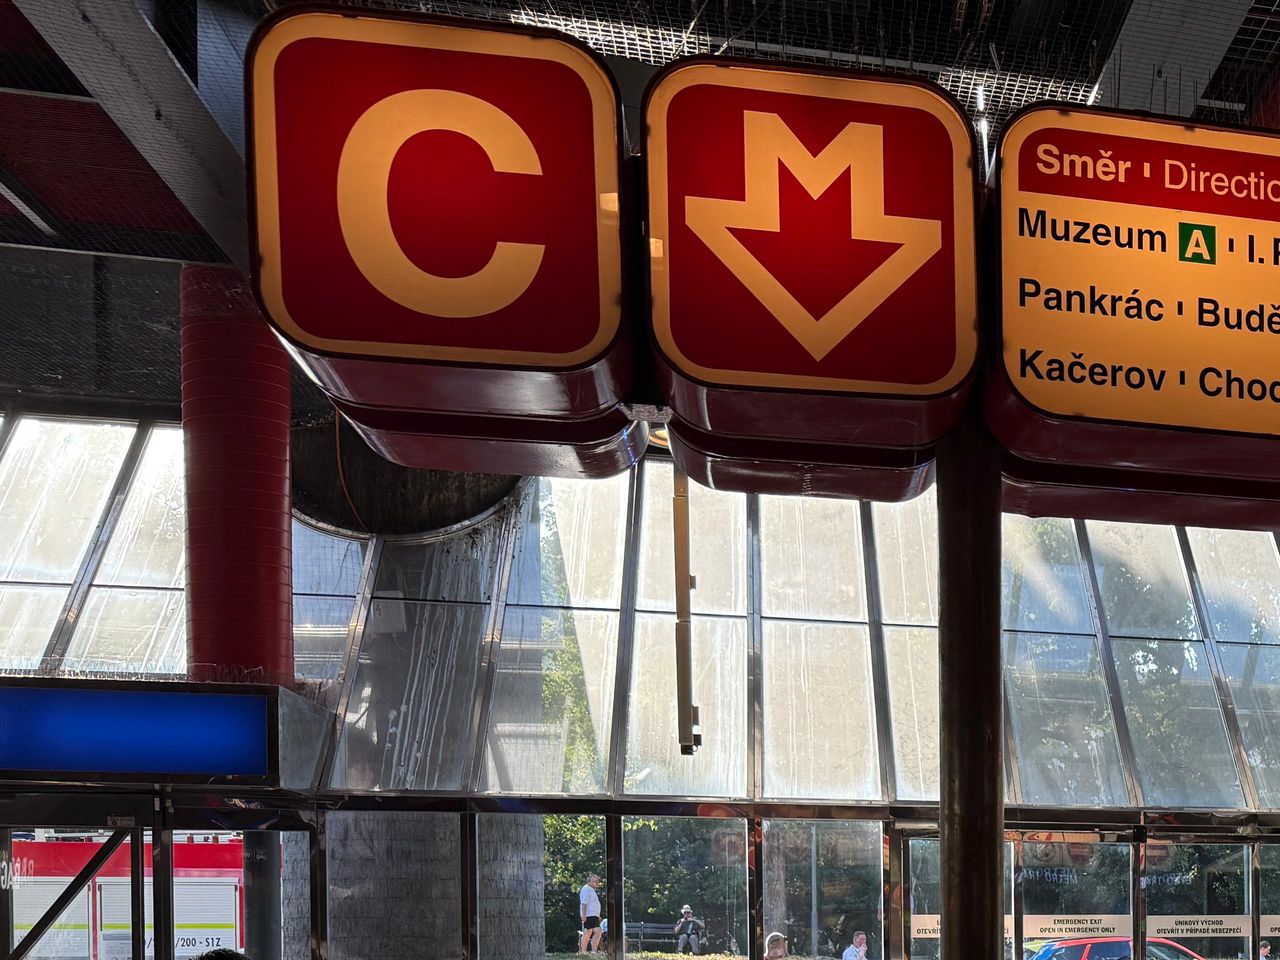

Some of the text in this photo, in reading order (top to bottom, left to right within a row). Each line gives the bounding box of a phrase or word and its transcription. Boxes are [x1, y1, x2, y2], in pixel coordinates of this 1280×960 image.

[1036, 143, 1132, 183] Směr
[337, 88, 546, 319] C
[1018, 207, 1168, 253] Muzeum
[1186, 230, 1211, 260] A
[1018, 278, 1164, 321] Pankrác
[1018, 349, 1166, 391] Kačerov
[205, 937, 222, 948] S1Z
[1200, 918, 1223, 926] VÝCHOD
